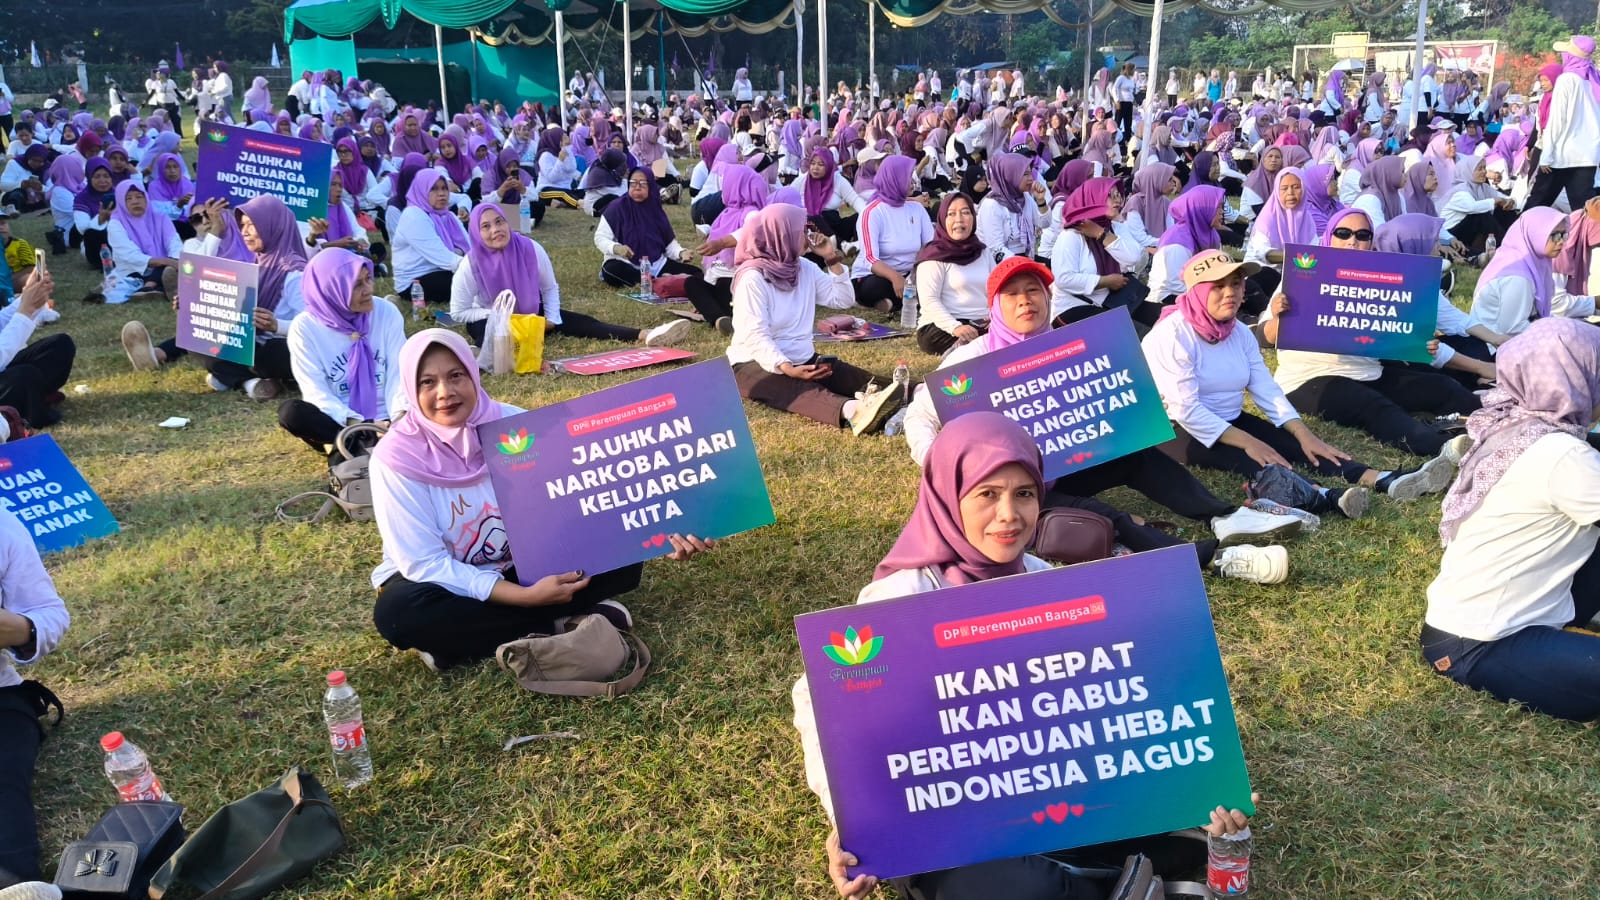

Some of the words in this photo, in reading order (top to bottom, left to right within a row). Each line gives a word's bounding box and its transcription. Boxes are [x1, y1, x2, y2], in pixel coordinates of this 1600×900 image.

[235, 163, 306, 184] KELUARGA
[239, 151, 303, 171] JAUHKAN
[217, 171, 285, 192] INDONESIA
[287, 184, 319, 198] DARI
[1193, 255, 1235, 276] SPO
[199, 279, 238, 296] MENCEGAH
[200, 292, 219, 305] LEBIH
[219, 297, 236, 308] BAIK
[1320, 284, 1412, 303] PEREMPUAN
[190, 302, 206, 313] DARI
[207, 305, 248, 324] MENGOBATI
[1335, 301, 1397, 317] BANGSA
[1316, 314, 1413, 334] HARAPANKU
[989, 354, 1112, 408] PEREMPUAN
[1002, 396, 1060, 423] NGSA
[1063, 369, 1134, 405] UNTUK
[591, 408, 637, 428] Perempuan
[637, 400, 666, 416] Bangsa
[1023, 389, 1138, 437] ANGKITAN
[571, 415, 693, 466] JAUHKAN
[0, 468, 46, 490] UAN
[545, 449, 671, 500] NARKOBA
[674, 429, 737, 464] DARI
[16, 481, 62, 503] PRO
[578, 463, 718, 516] KELUARGA
[12, 490, 93, 521] ERAAN
[620, 499, 684, 531] KITA
[33, 508, 93, 537] ANAK
[970, 616, 1042, 636] Perempuan
[1045, 605, 1090, 622] Bangsa
[934, 663, 1019, 700] IKAN
[1026, 641, 1134, 684] SEPAT
[938, 698, 1024, 735] IKAN
[1032, 676, 1149, 718] GABUS
[887, 720, 1095, 780] PEREMPUAN
[1103, 698, 1215, 743] HEBAT
[905, 759, 1088, 813] INDONESIA
[1095, 736, 1214, 781] BAGUS
